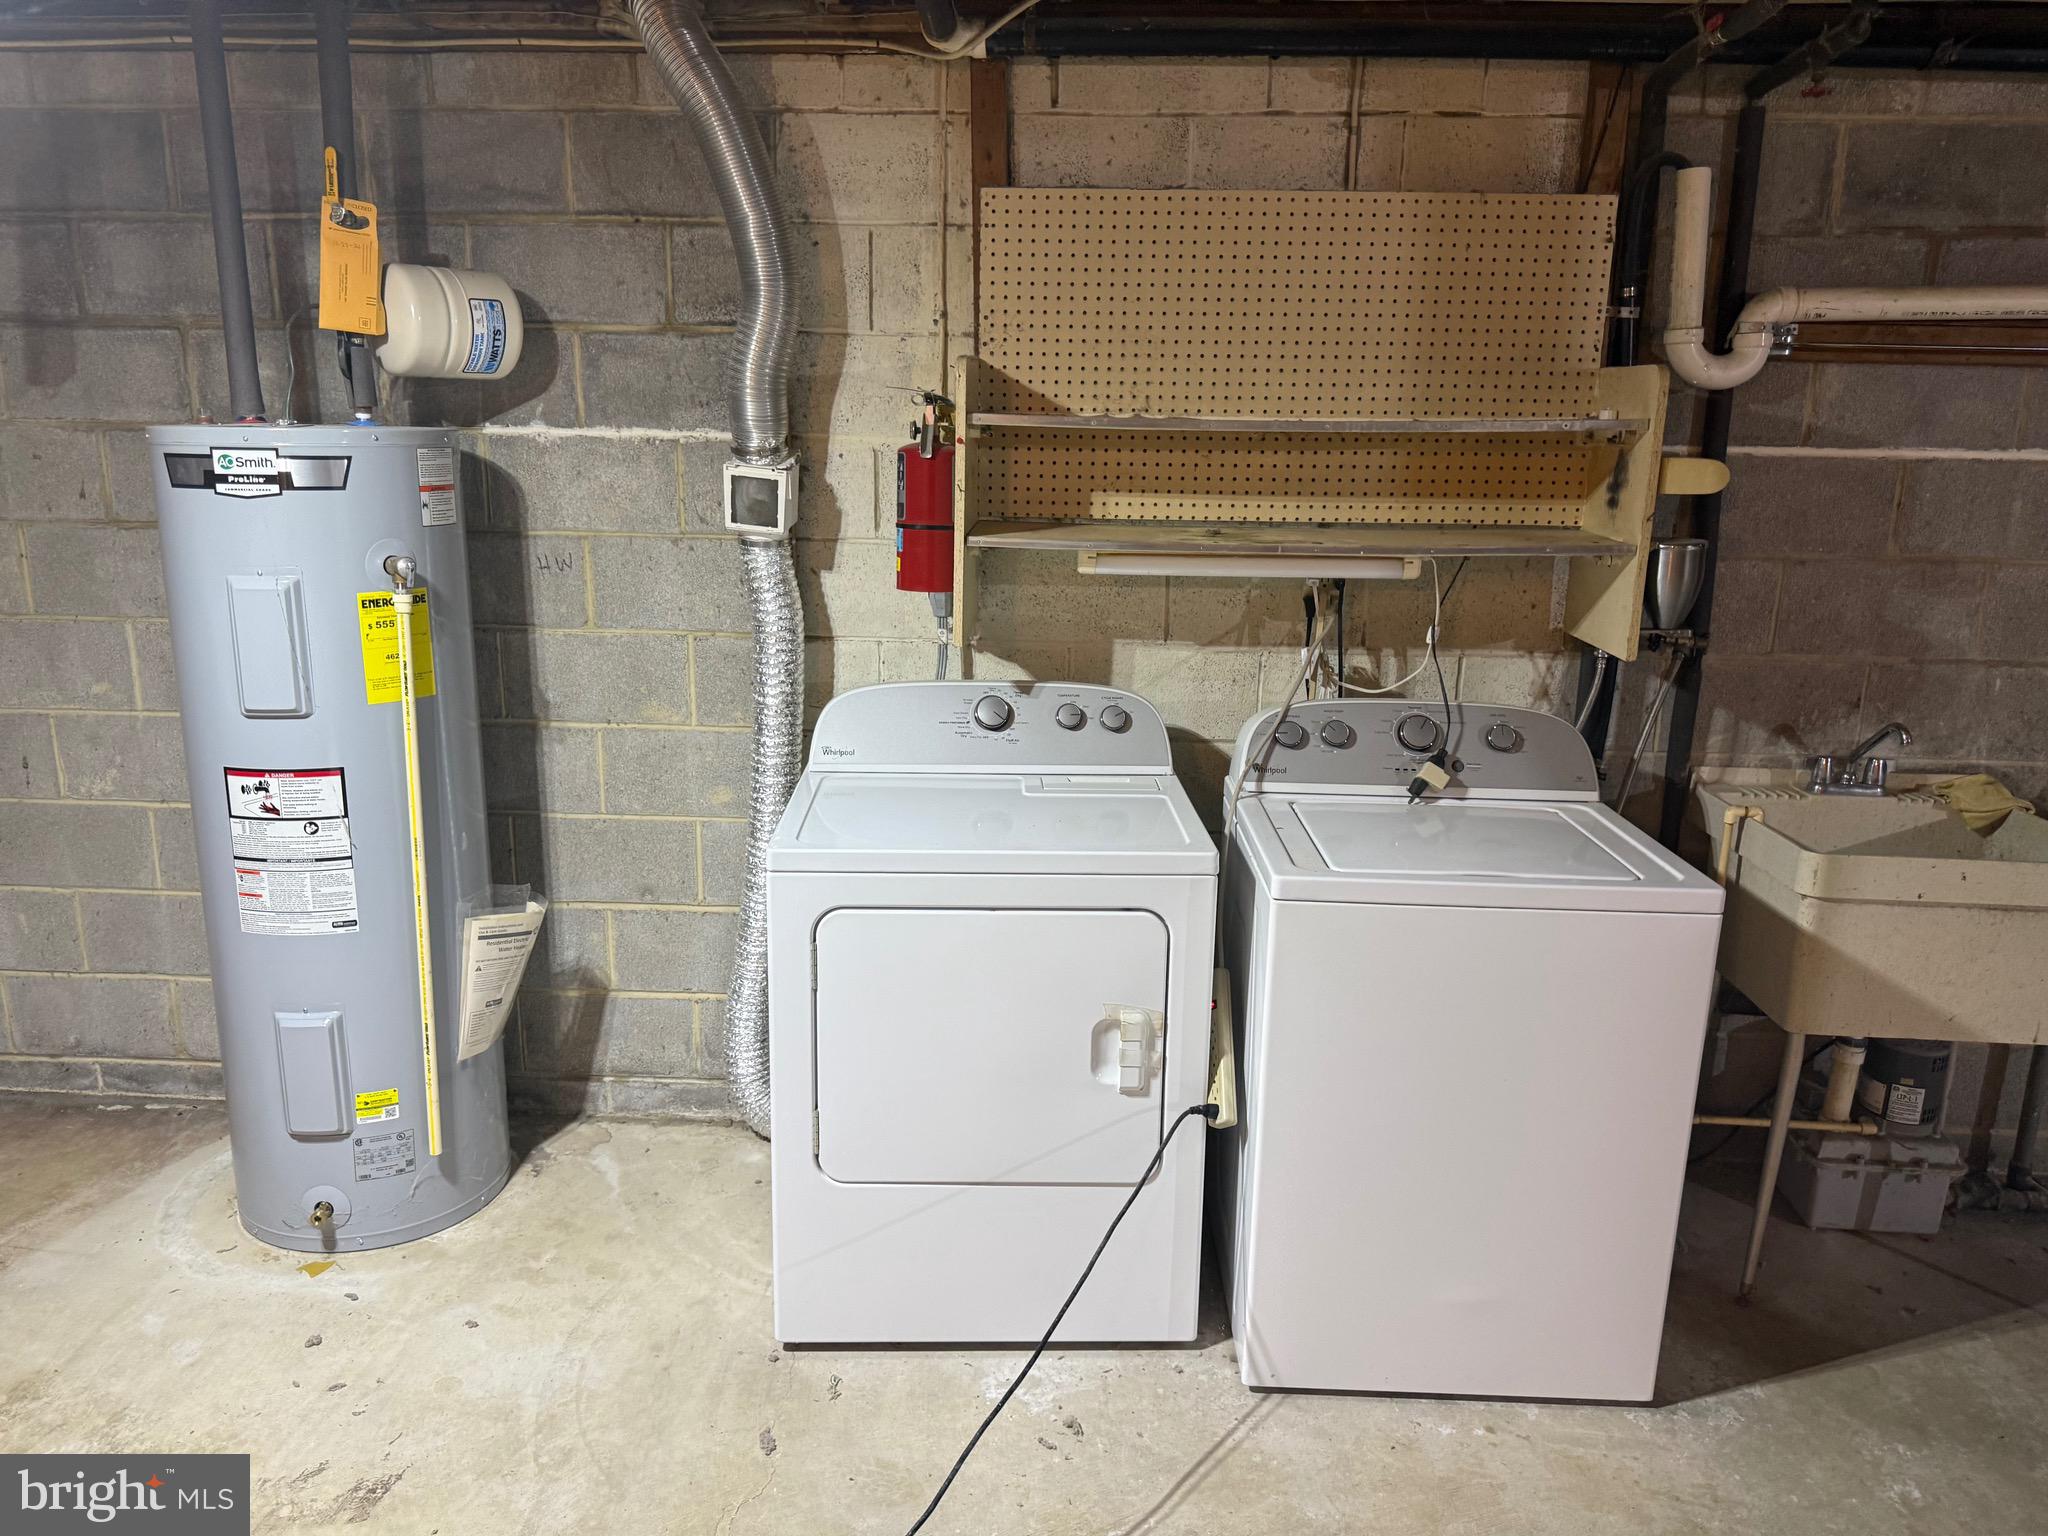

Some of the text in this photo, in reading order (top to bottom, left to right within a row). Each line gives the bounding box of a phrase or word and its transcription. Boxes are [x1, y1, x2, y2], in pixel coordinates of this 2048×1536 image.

[488, 328, 502, 362] WATTS
[375, 619, 396, 629] 555
[822, 748, 855, 757] Whirlpool
[1252, 763, 1287, 776] Whirlpool
[486, 938, 513, 946] Residential
